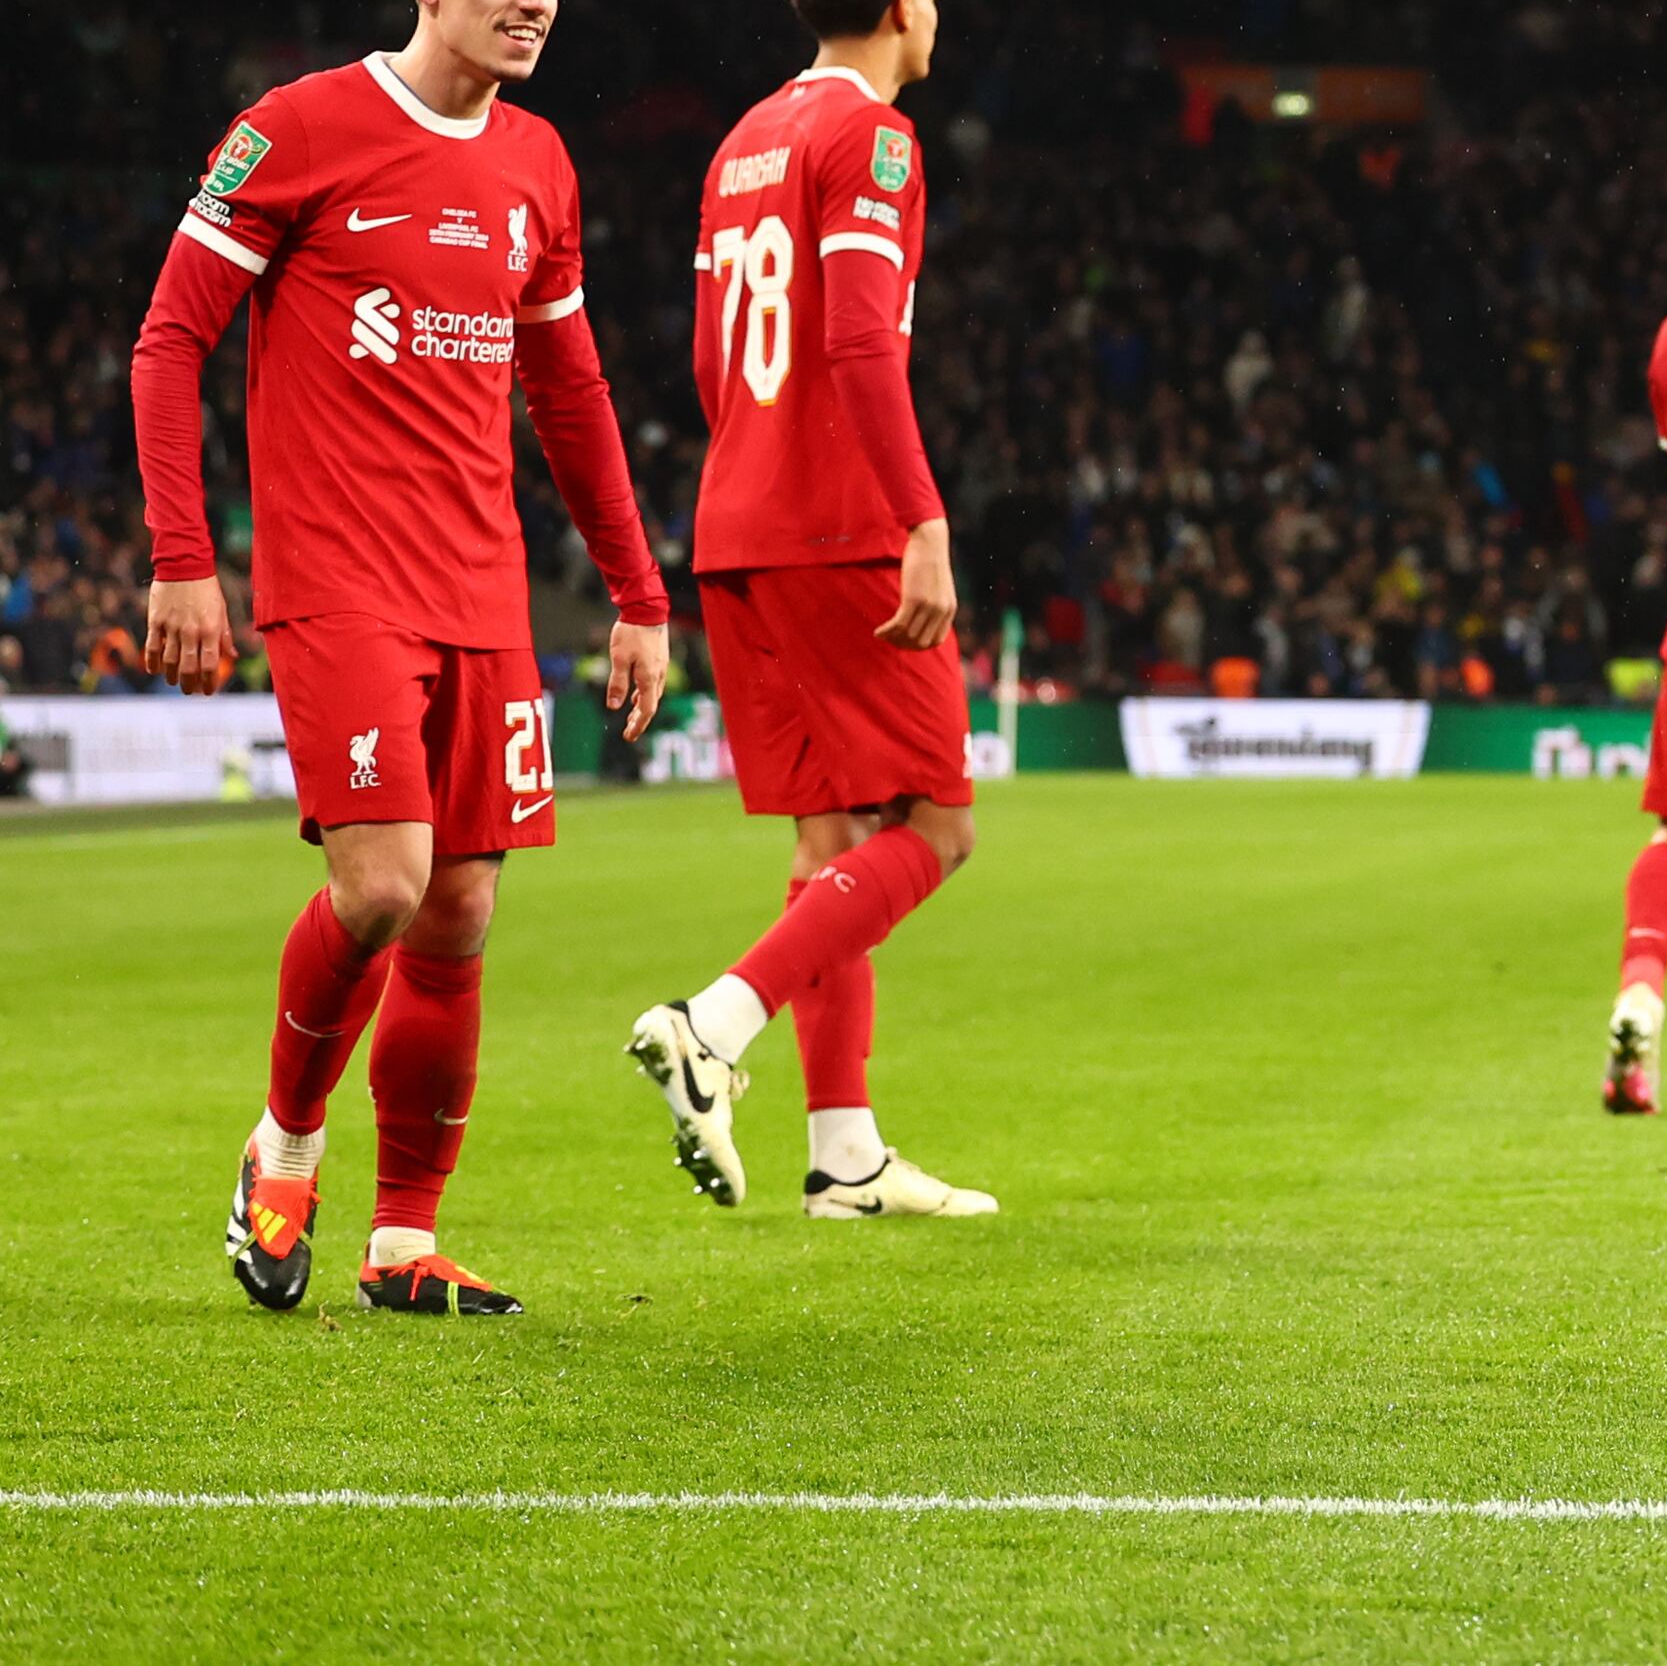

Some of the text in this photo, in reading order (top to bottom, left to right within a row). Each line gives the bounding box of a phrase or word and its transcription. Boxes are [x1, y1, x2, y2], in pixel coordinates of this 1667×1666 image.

[411, 331, 515, 363] chartered
[712, 214, 794, 408] 78
[505, 698, 553, 794] 21
